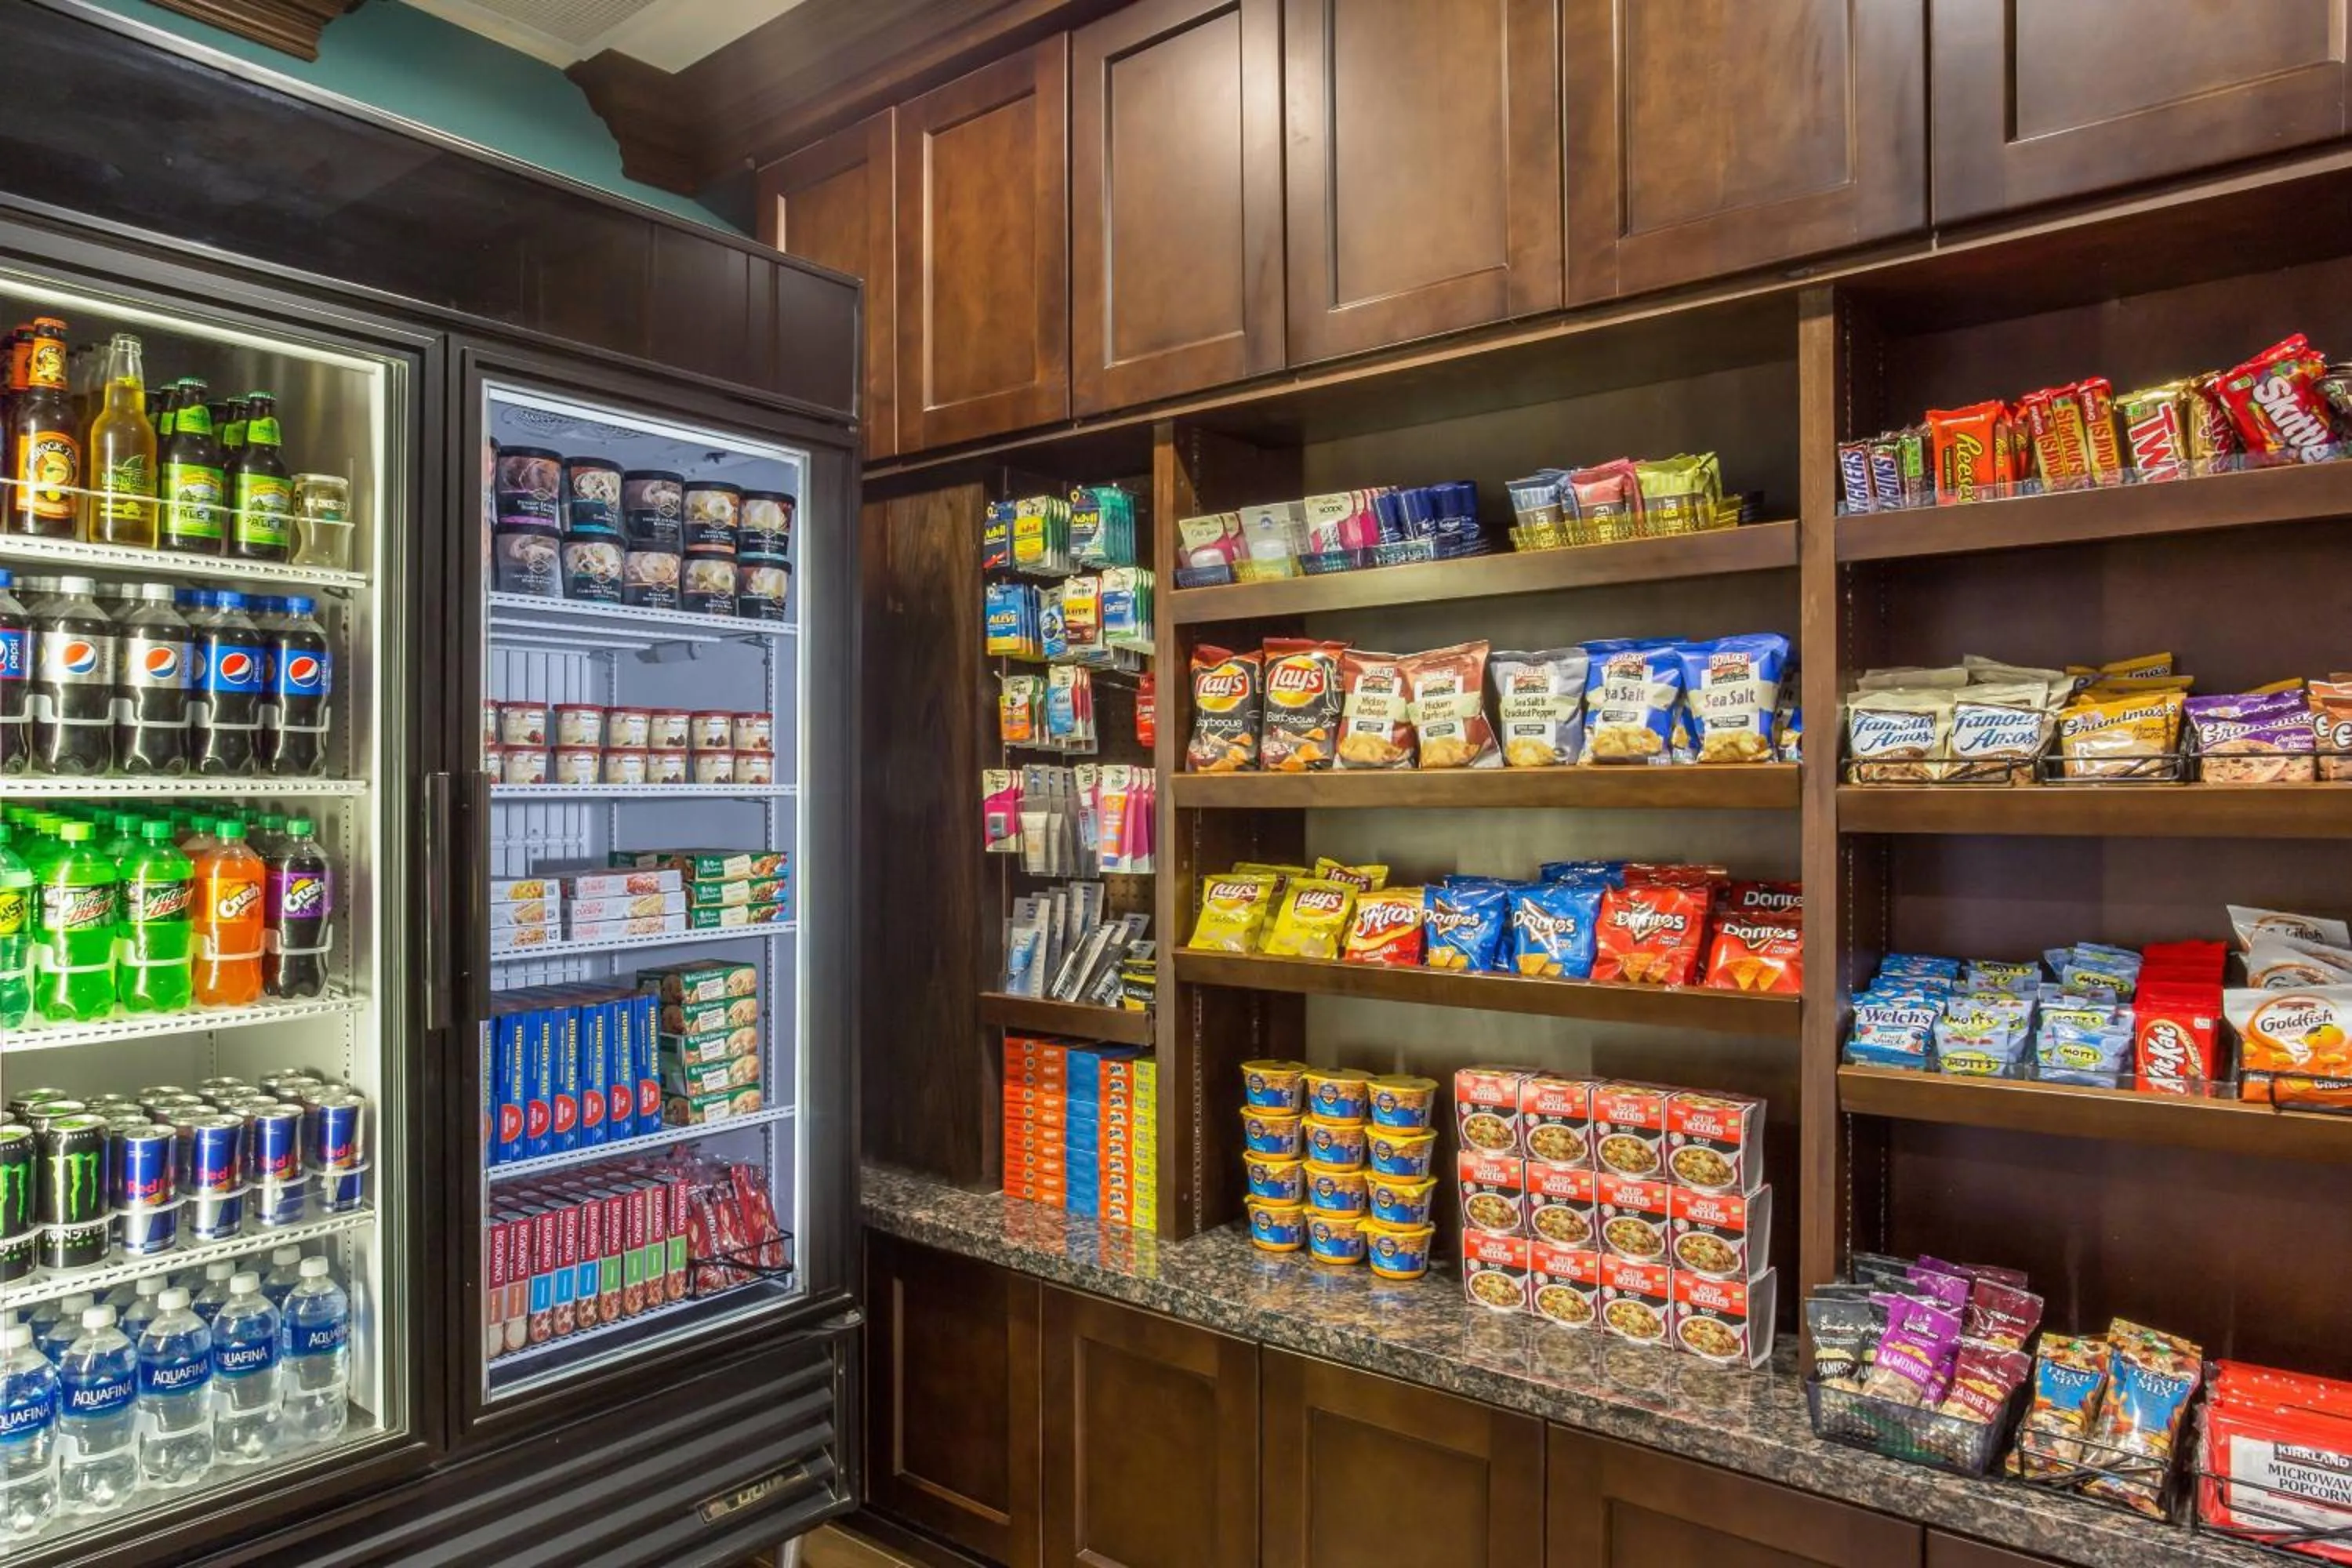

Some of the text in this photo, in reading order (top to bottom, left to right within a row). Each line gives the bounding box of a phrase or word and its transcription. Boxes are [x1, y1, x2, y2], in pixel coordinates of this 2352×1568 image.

[2129, 401, 2178, 482] TWI
[1842, 451, 1869, 514] NICKERS
[1873, 457, 1901, 510] SNICK
[9, 639, 19, 669] pepsi
[1198, 673, 1247, 697] Lay's
[1271, 665, 1324, 692] Lay's
[1619, 688, 1644, 701] Salt
[1705, 688, 1755, 706] Sea Salt
[1266, 710, 1316, 724] Barbecue
[218, 877, 262, 919] Crush
[284, 877, 325, 913] Crush
[1210, 882, 1258, 900] Lay's
[1296, 891, 1343, 909] Lay's
[1744, 891, 1803, 906] Dorito
[1357, 902, 1415, 937] Fritos
[1722, 924, 1797, 941] Doritos
[1865, 1008, 1929, 1025] Welch's
[2260, 1008, 2334, 1033] Goldfish
[127, 1178, 157, 1193] Red
[216, 1346, 267, 1367] AQUAFINA
[152, 1359, 208, 1385] AQUAFINA
[2051, 1374, 2082, 1388] MIX
[73, 1380, 132, 1407] AQUAFINA
[2136, 1377, 2170, 1399] MIX
[0, 1401, 50, 1430] QUAFINA
[2276, 1443, 2350, 1468] KIRKLAND
[2267, 1462, 2352, 1490] MICROWAV
[2278, 1478, 2352, 1503] POPCORN
